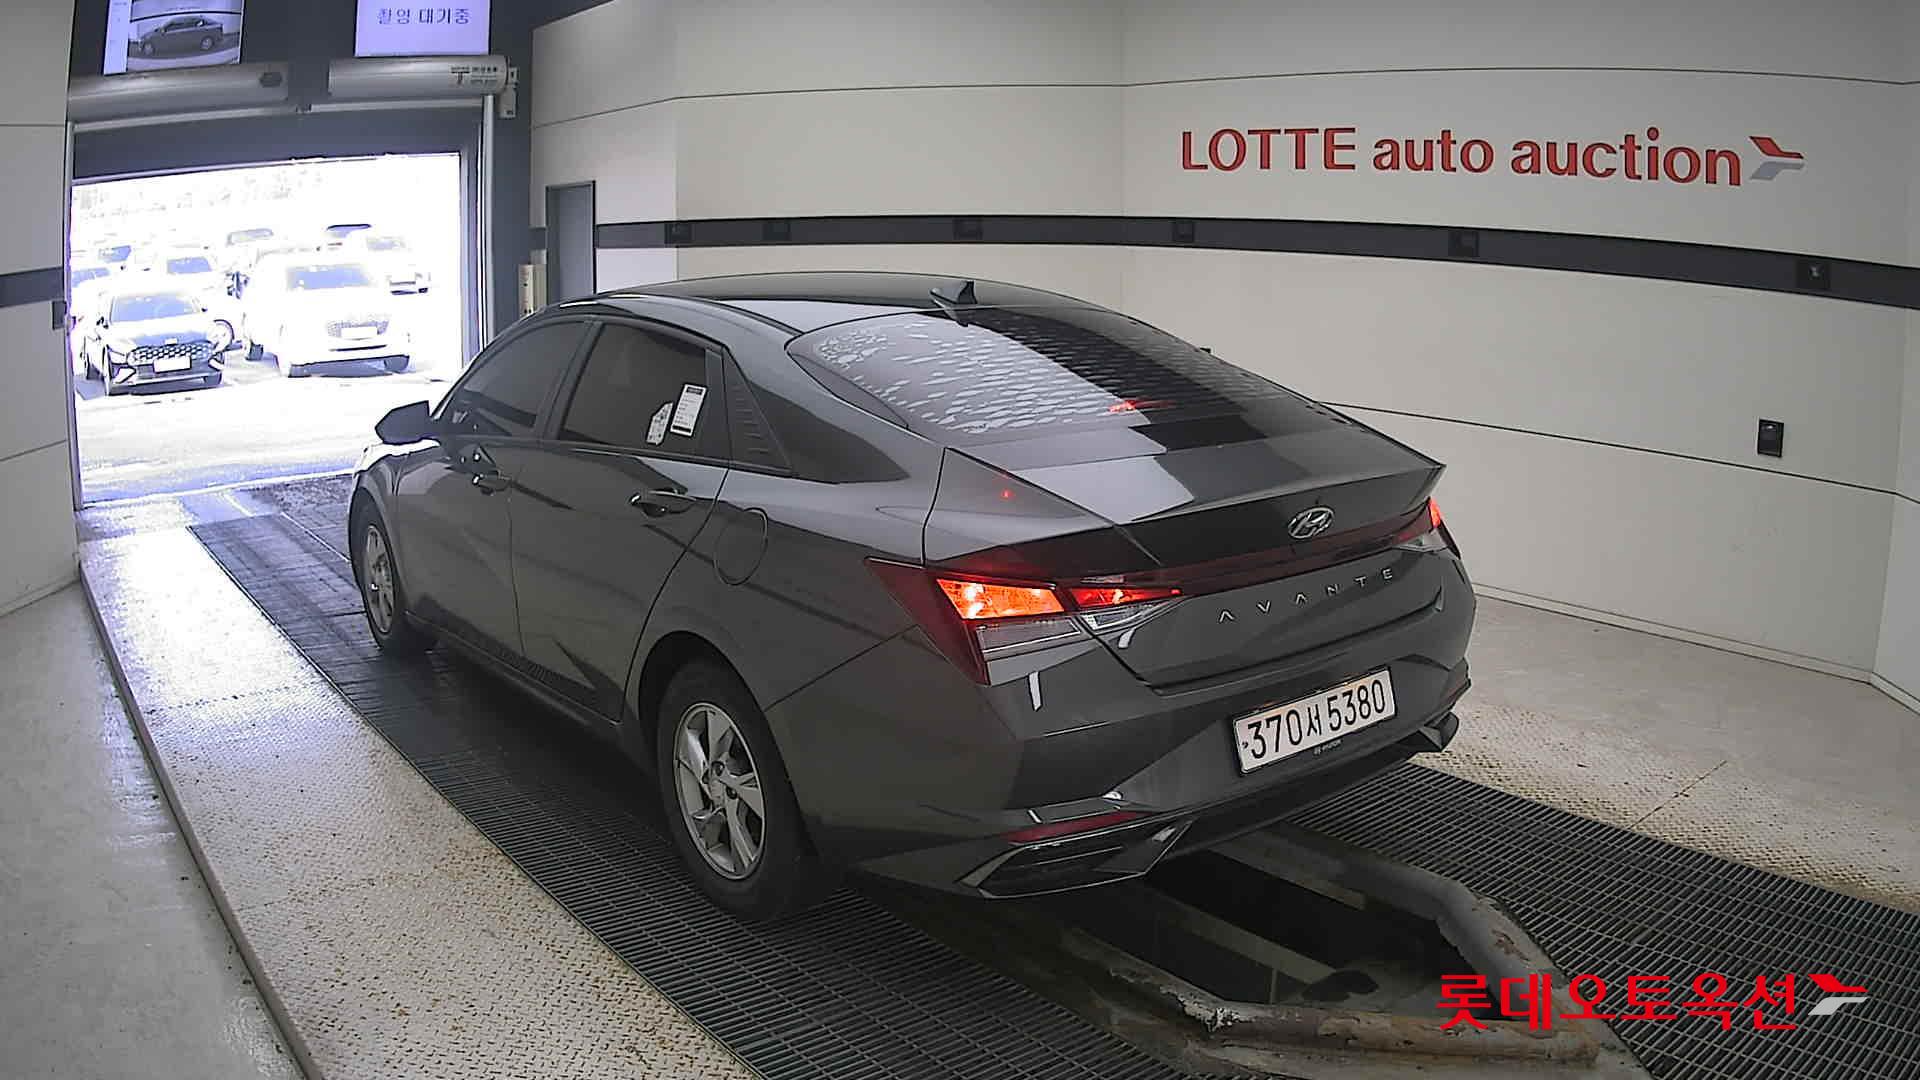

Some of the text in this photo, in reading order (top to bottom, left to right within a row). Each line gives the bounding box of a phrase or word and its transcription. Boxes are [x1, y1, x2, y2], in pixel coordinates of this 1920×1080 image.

[419, 7, 470, 25] 대기중
[1181, 126, 1742, 187] LOTTE auto auction
[1218, 567, 1393, 624] AVANTE
[1246, 679, 1386, 760] 370서 5380
